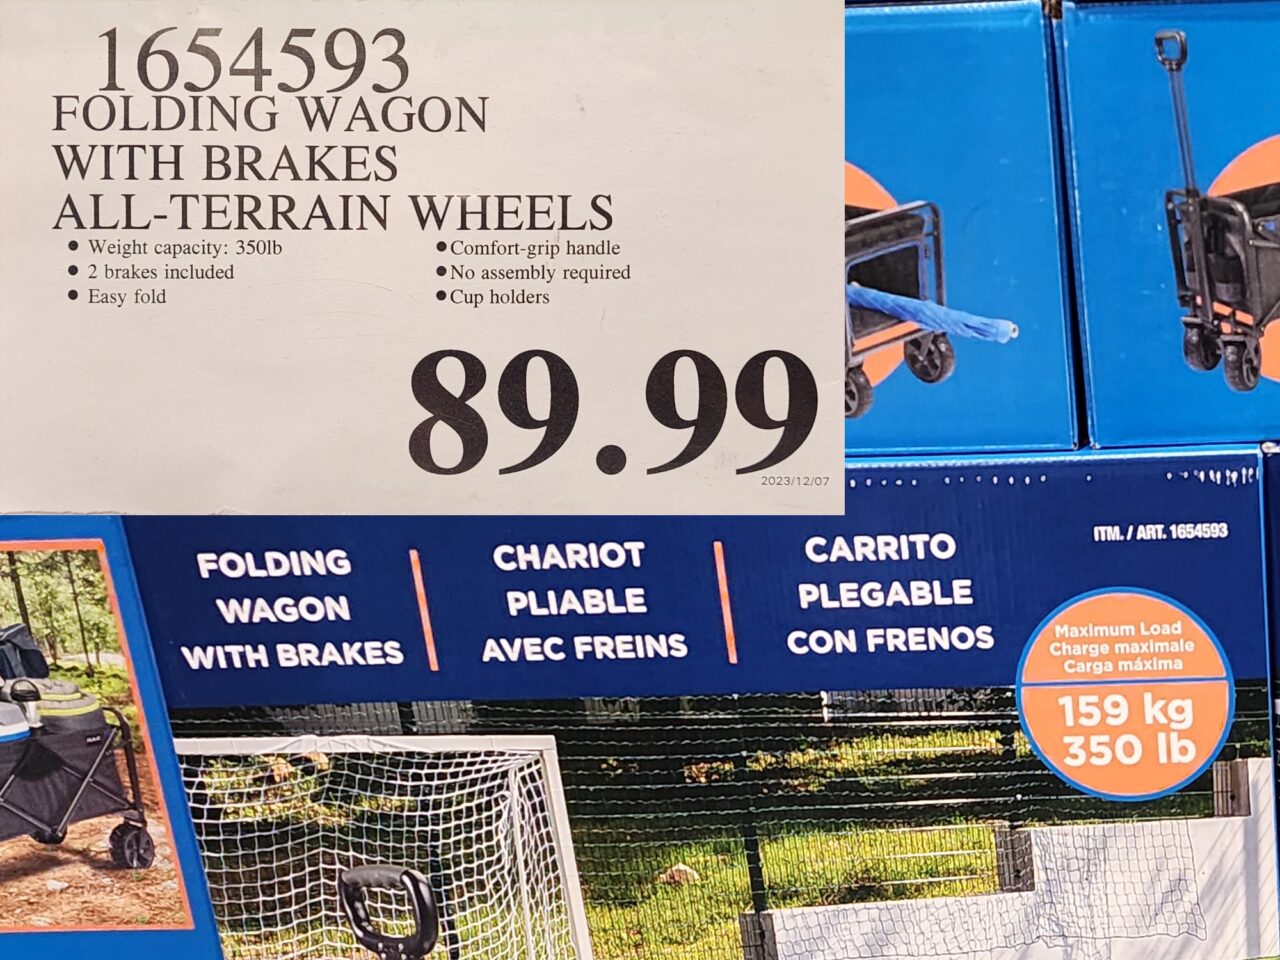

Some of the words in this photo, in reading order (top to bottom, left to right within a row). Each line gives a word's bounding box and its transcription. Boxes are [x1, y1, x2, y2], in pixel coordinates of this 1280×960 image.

[97, 27, 409, 93] 1654593
[52, 95, 278, 132] FOLDING
[296, 95, 489, 132] WAGON
[52, 144, 183, 181] WITH
[202, 144, 398, 182] BRAKES
[52, 194, 390, 232] ALL-TERRAIN
[410, 194, 613, 232] WHEELS
[89, 239, 148, 258] Weight
[154, 239, 229, 258] capacity:
[235, 239, 283, 256] 350lb
[450, 239, 560, 259] Comfort-grip
[566, 239, 620, 256] handle
[88, 264, 99, 280] 2
[104, 263, 159, 281] brakes
[164, 263, 234, 281] included
[450, 264, 475, 281] No
[480, 263, 557, 285] assembly
[562, 263, 631, 285] required
[88, 289, 122, 309] Easy
[128, 288, 166, 305] fold
[450, 289, 484, 310] Cup
[490, 288, 550, 306] holders
[408, 349, 819, 476] 89.99
[1094, 526, 1124, 541] ITM.
[1137, 525, 1167, 540] ART.
[1170, 523, 1228, 539] 1654593
[493, 542, 645, 570] CHARIOT
[805, 534, 956, 563] CARRITO
[196, 550, 352, 578] FOLDING
[507, 588, 648, 616] PLIABLE
[798, 580, 974, 609] PLEGABLE
[216, 596, 351, 623] WAGON
[787, 628, 857, 655] CON
[867, 625, 995, 652] FRENOS
[1054, 622, 1135, 638] Maximum
[1140, 621, 1183, 635] Load
[181, 645, 269, 670] WITH
[277, 641, 405, 667] BRAKES
[482, 636, 565, 662] AVEC
[575, 634, 689, 660] FREINS
[1050, 640, 1111, 659] Charge
[1115, 638, 1195, 655] maximale
[1064, 658, 1113, 675] Carga
[1117, 655, 1184, 672] máxima
[1057, 693, 1130, 727] 159
[1143, 692, 1194, 732] kg
[1062, 734, 1143, 768] 350
[1158, 732, 1196, 765] lb
